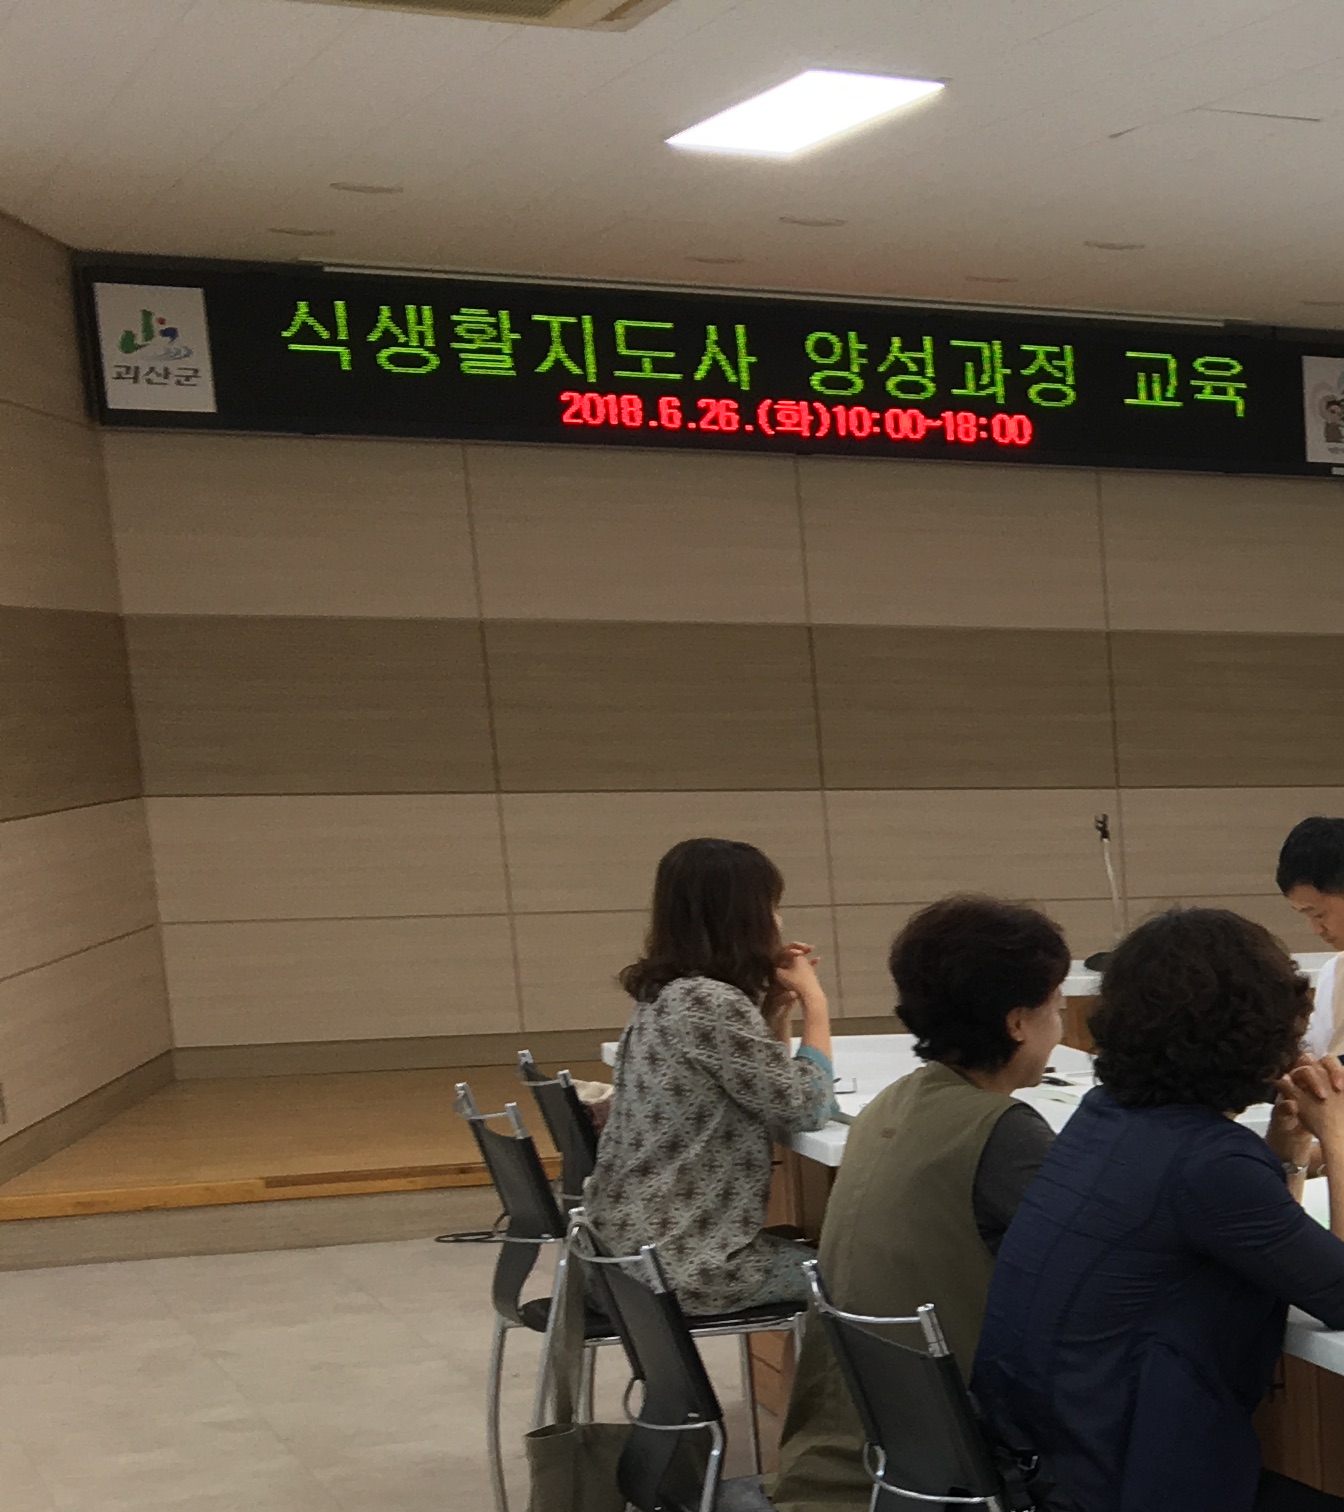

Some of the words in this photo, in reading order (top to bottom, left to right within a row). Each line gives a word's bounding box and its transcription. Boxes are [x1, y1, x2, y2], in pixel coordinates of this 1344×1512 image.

[111, 364, 202, 387] 괴산군
[280, 301, 758, 391] 식생활지도사
[804, 331, 1077, 407] 양성과정
[1123, 350, 1248, 418] 교육
